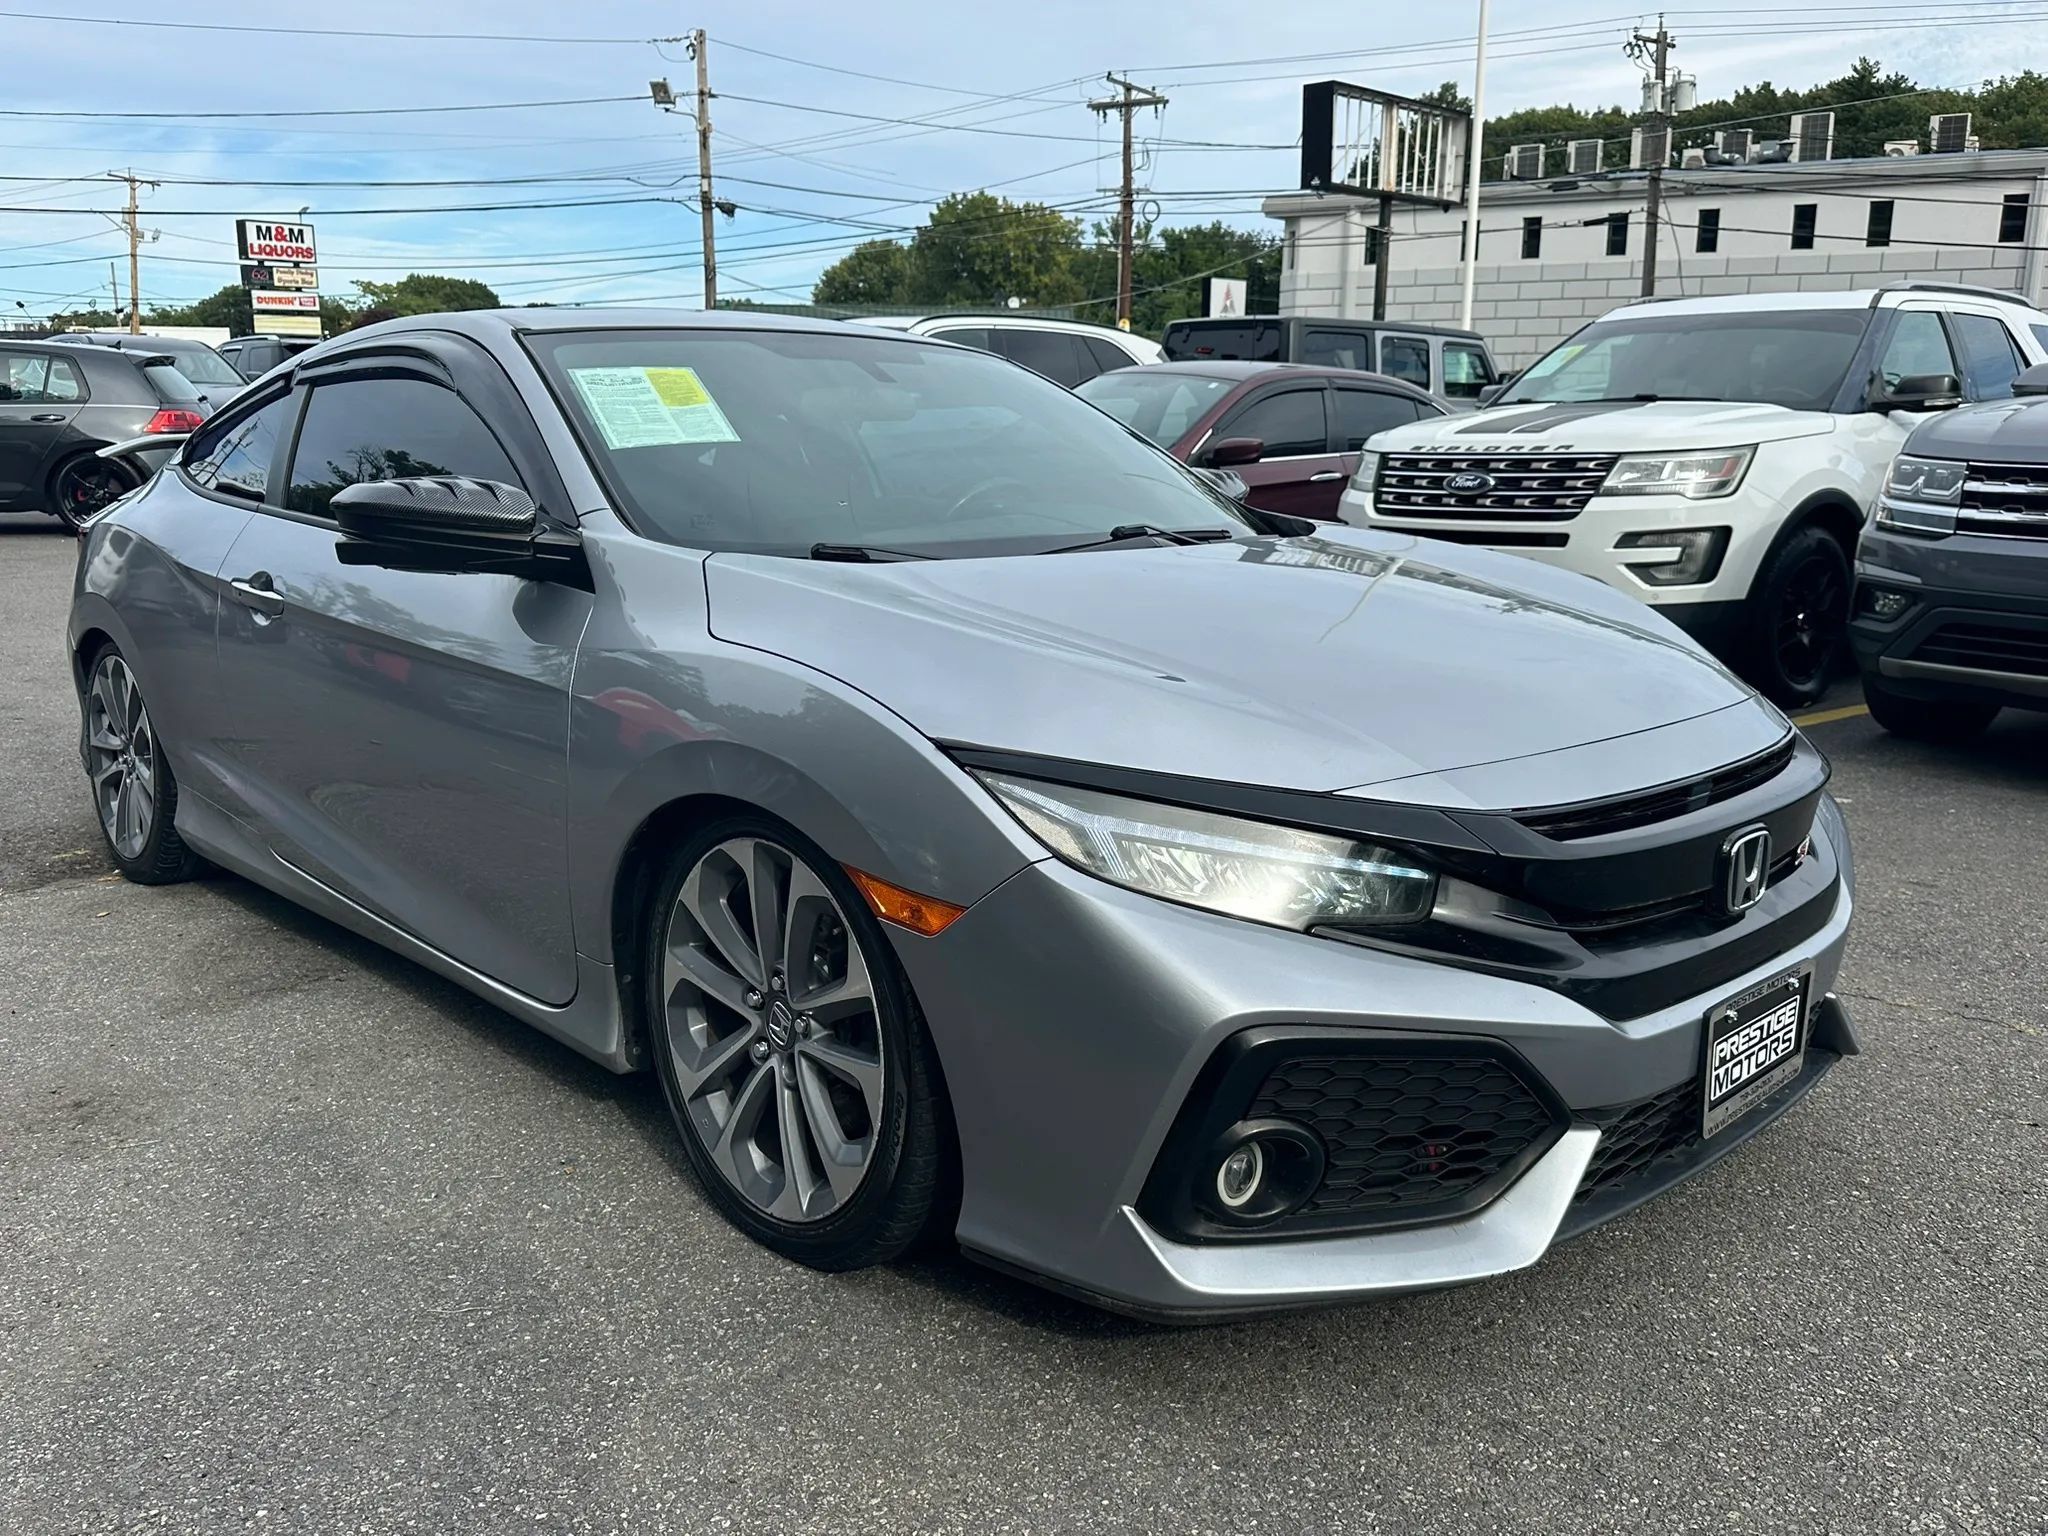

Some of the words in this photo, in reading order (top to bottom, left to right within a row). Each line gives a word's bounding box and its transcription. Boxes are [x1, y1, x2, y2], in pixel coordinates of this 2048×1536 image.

[256, 225, 305, 243] M&M
[249, 243, 314, 258] LIQUORS
[1451, 475, 1481, 488] Ford
[1725, 984, 1766, 1010] PRESTIGE
[1766, 968, 1801, 990] MOTORS
[1715, 1004, 1797, 1068] PRESTIGE
[1713, 1028, 1794, 1098] MOTORS
